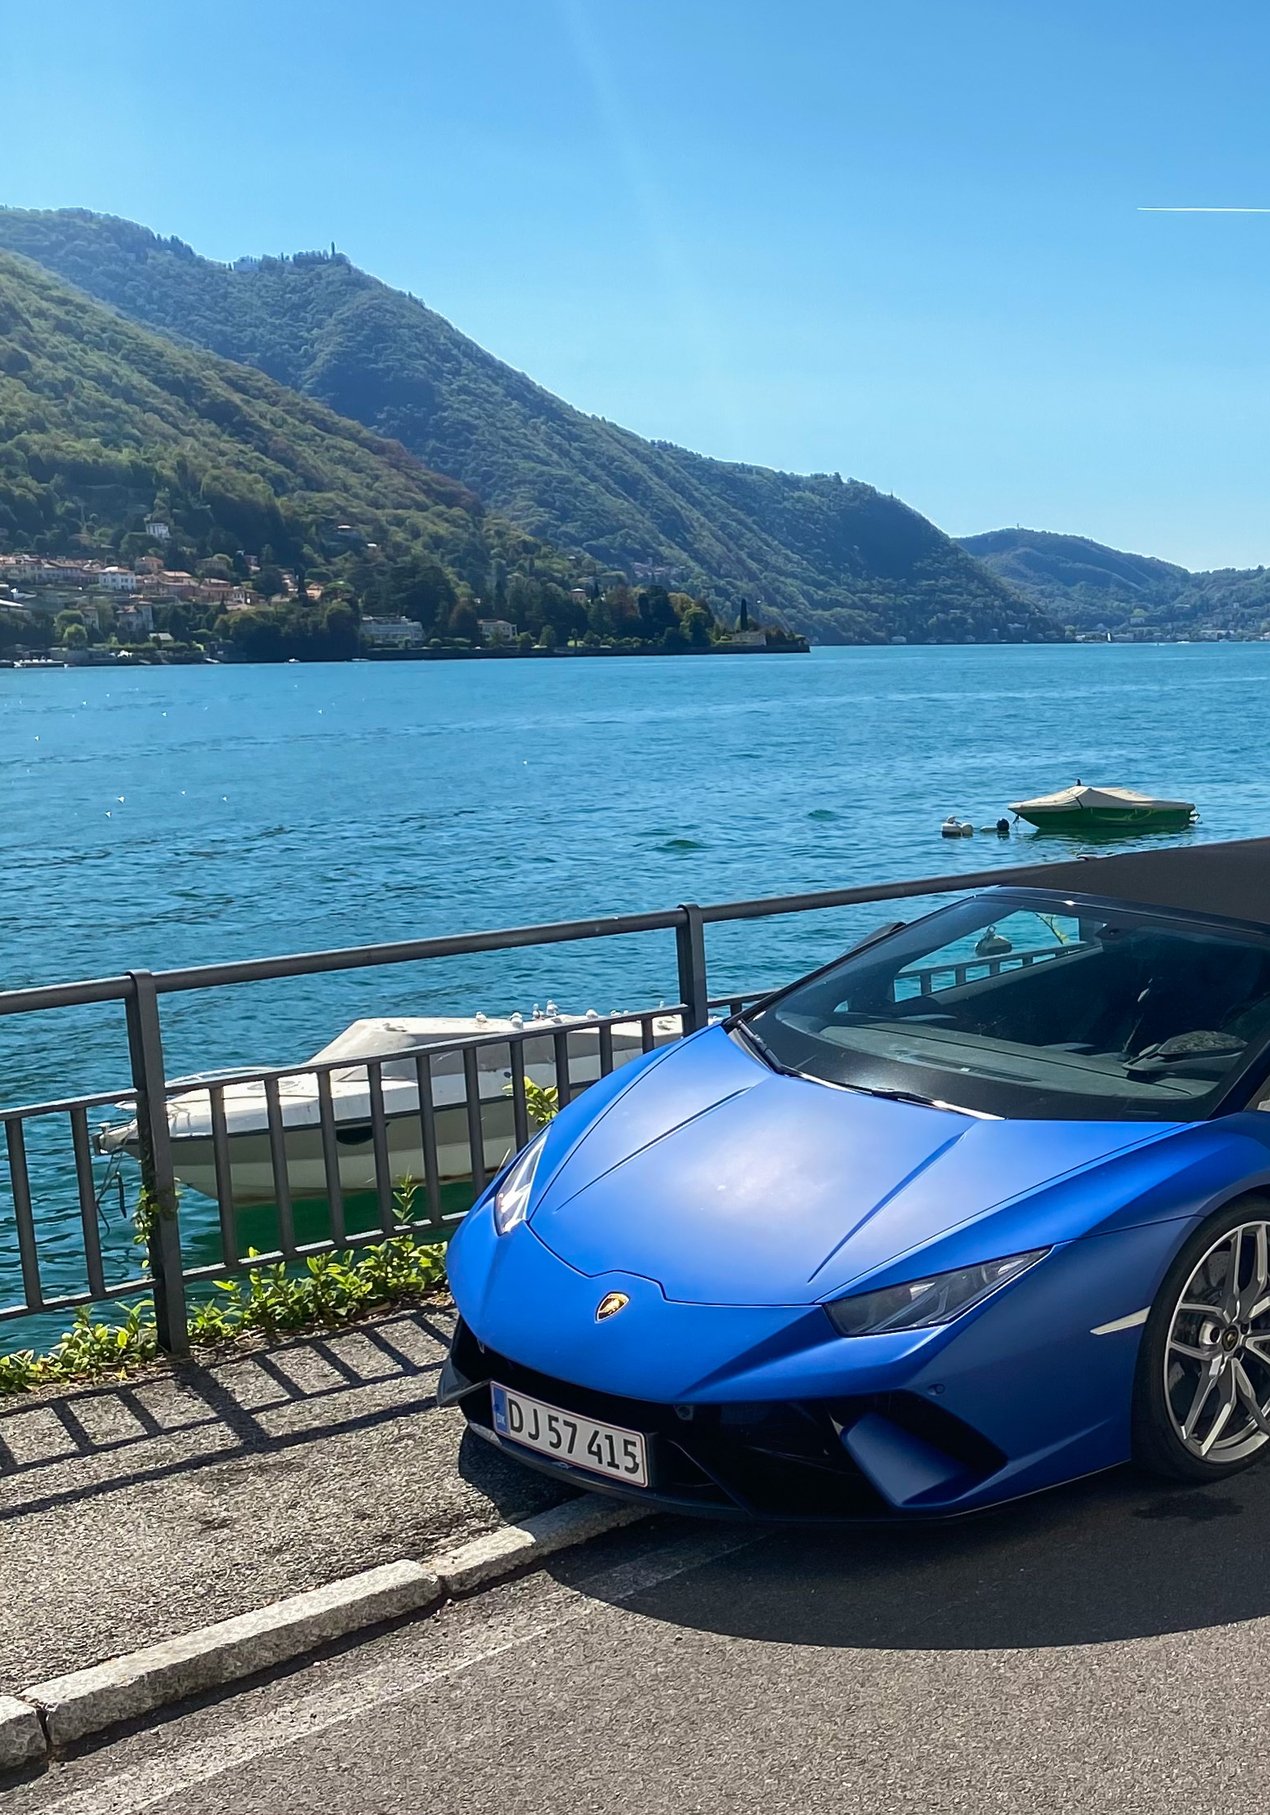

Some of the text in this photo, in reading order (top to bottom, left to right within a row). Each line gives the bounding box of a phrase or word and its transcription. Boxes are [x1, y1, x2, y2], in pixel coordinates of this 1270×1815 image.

[508, 1398, 640, 1474] DJ 57 415
